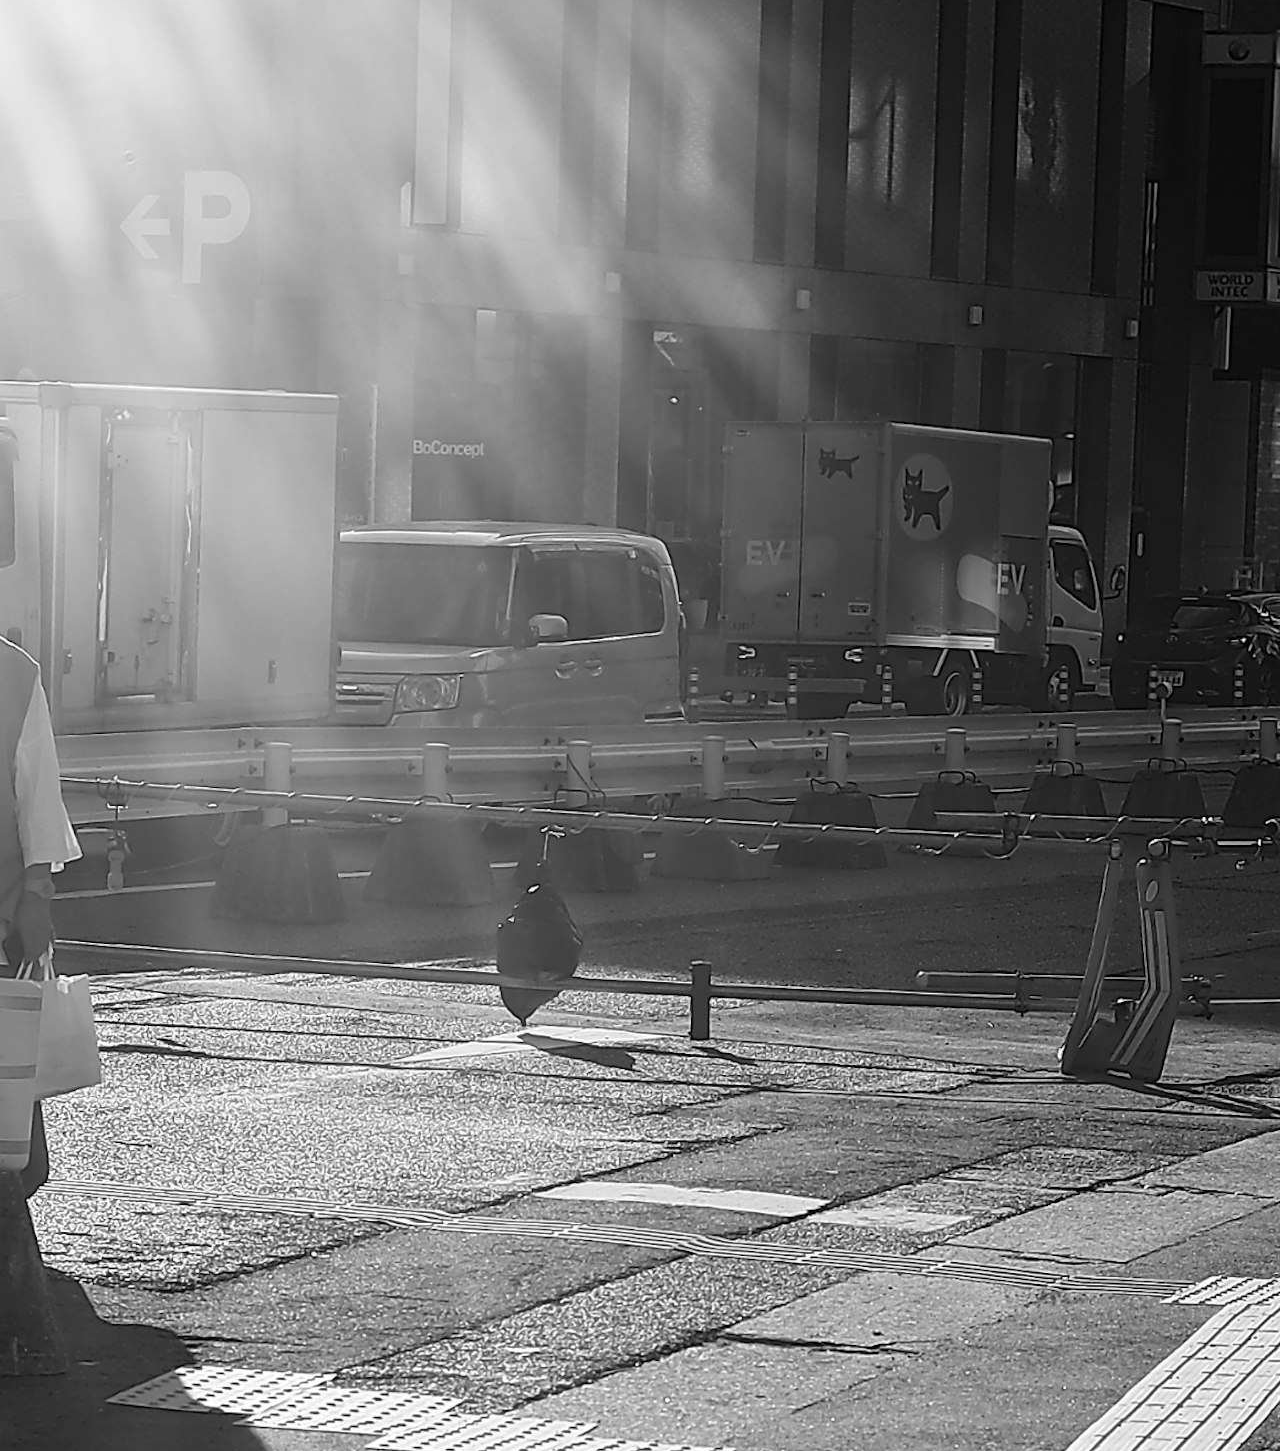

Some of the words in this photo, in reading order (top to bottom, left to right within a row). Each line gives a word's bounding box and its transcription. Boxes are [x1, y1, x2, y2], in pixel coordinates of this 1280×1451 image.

[183, 170, 251, 284] P
[1208, 274, 1254, 285] WORLD
[1211, 286, 1249, 297] INTEC
[413, 439, 485, 459] BoConcept
[746, 540, 786, 566] EV
[997, 563, 1026, 595] EV
